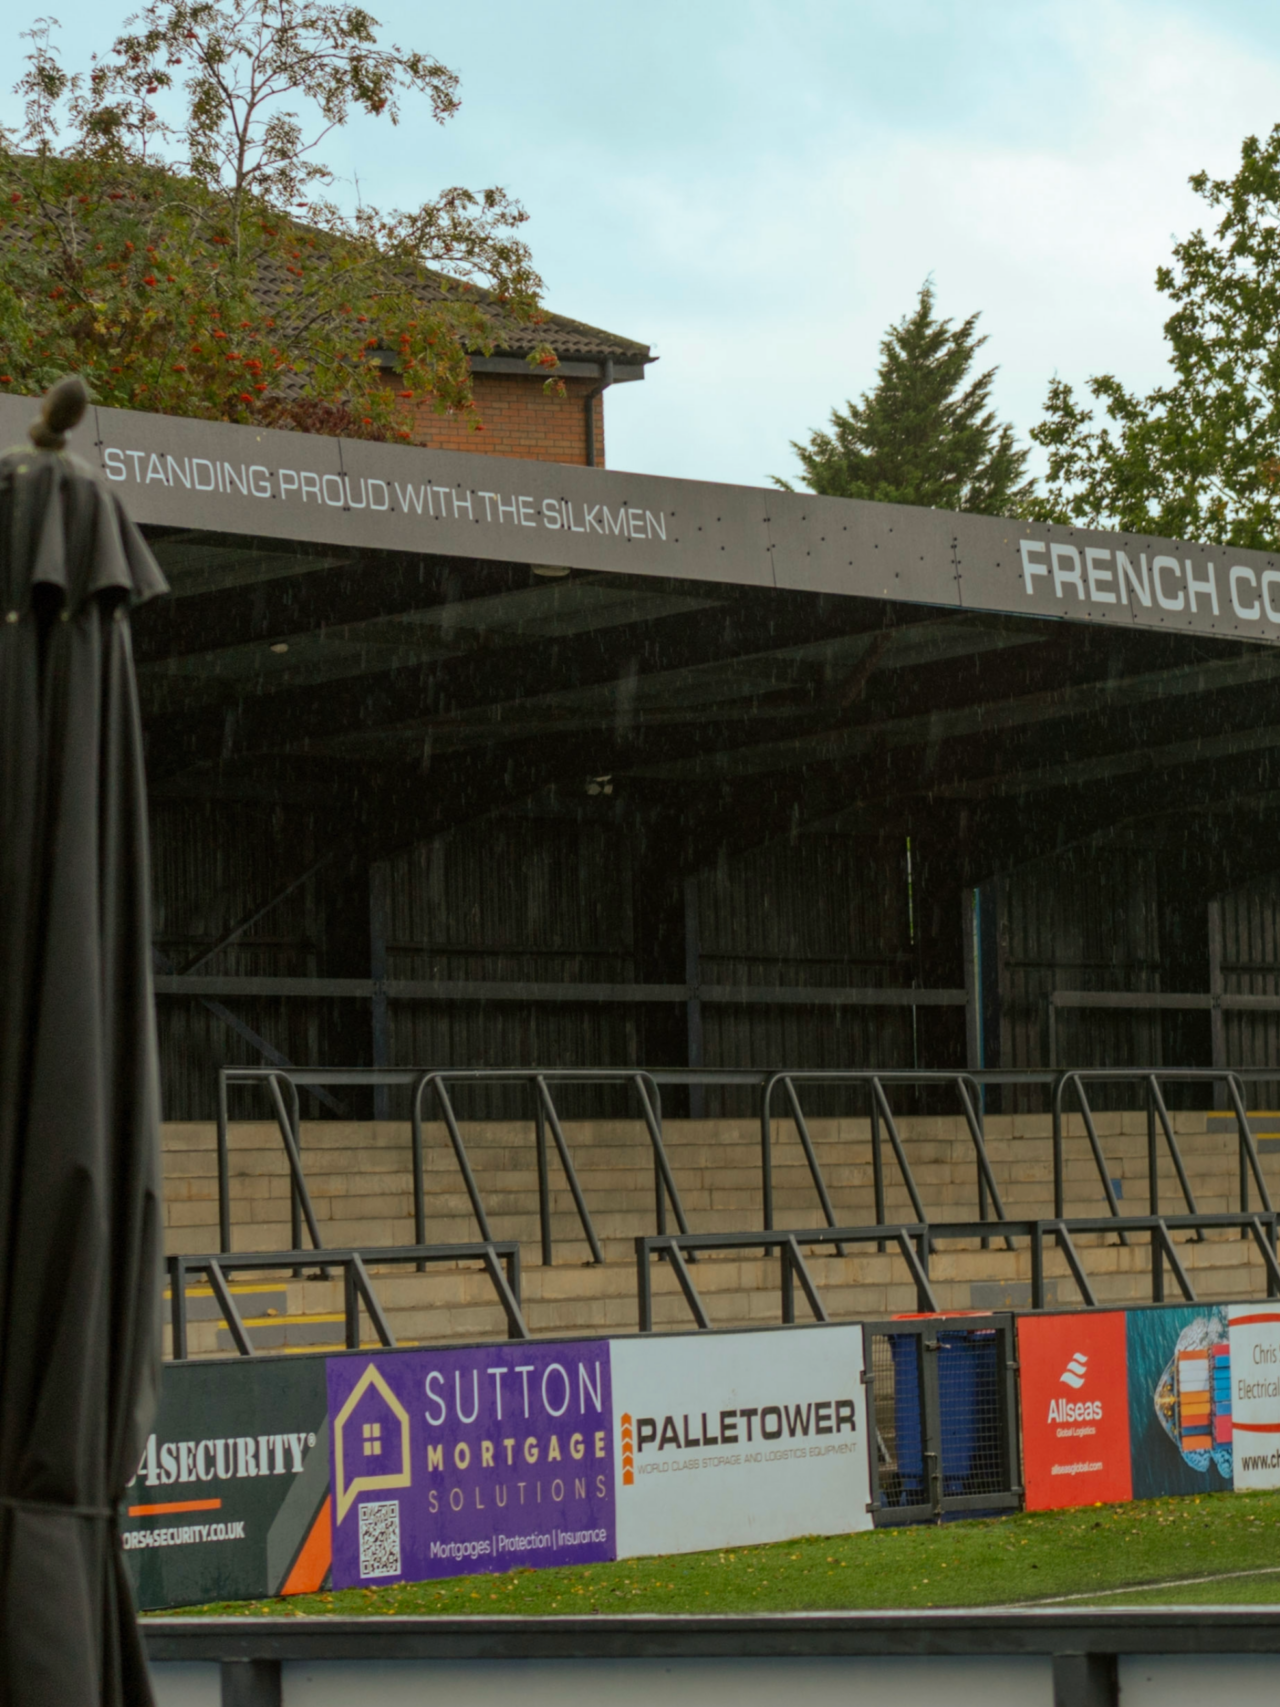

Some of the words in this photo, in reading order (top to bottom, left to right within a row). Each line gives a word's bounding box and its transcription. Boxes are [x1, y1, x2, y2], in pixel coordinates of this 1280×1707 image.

[103, 447, 271, 498] STANDING
[279, 469, 389, 511] PROUD
[395, 481, 473, 520] WITH
[478, 491, 537, 527] THE
[542, 499, 667, 541] SILKMEN
[1019, 540, 1220, 616] FRENCH
[1252, 1343, 1277, 1365] Chris
[424, 1361, 603, 1426] SUTTON
[1238, 1376, 1280, 1400] Electrical
[636, 1399, 857, 1453] PALLETOWER
[1047, 1398, 1103, 1424] Allseas
[427, 1431, 605, 1472] MORTGAGE
[638, 1462, 669, 1475] WORLD
[671, 1458, 700, 1472] CLASS
[702, 1455, 742, 1469] STORAGE
[744, 1452, 762, 1464] AND
[764, 1447, 808, 1462] LOGISTICS
[809, 1442, 857, 1457] EQUIPMENT
[428, 1475, 606, 1513] SOLUTIONS
[430, 1540, 491, 1561] Mortgages
[498, 1531, 551, 1552] Protection
[558, 1528, 607, 1546] Insurance
